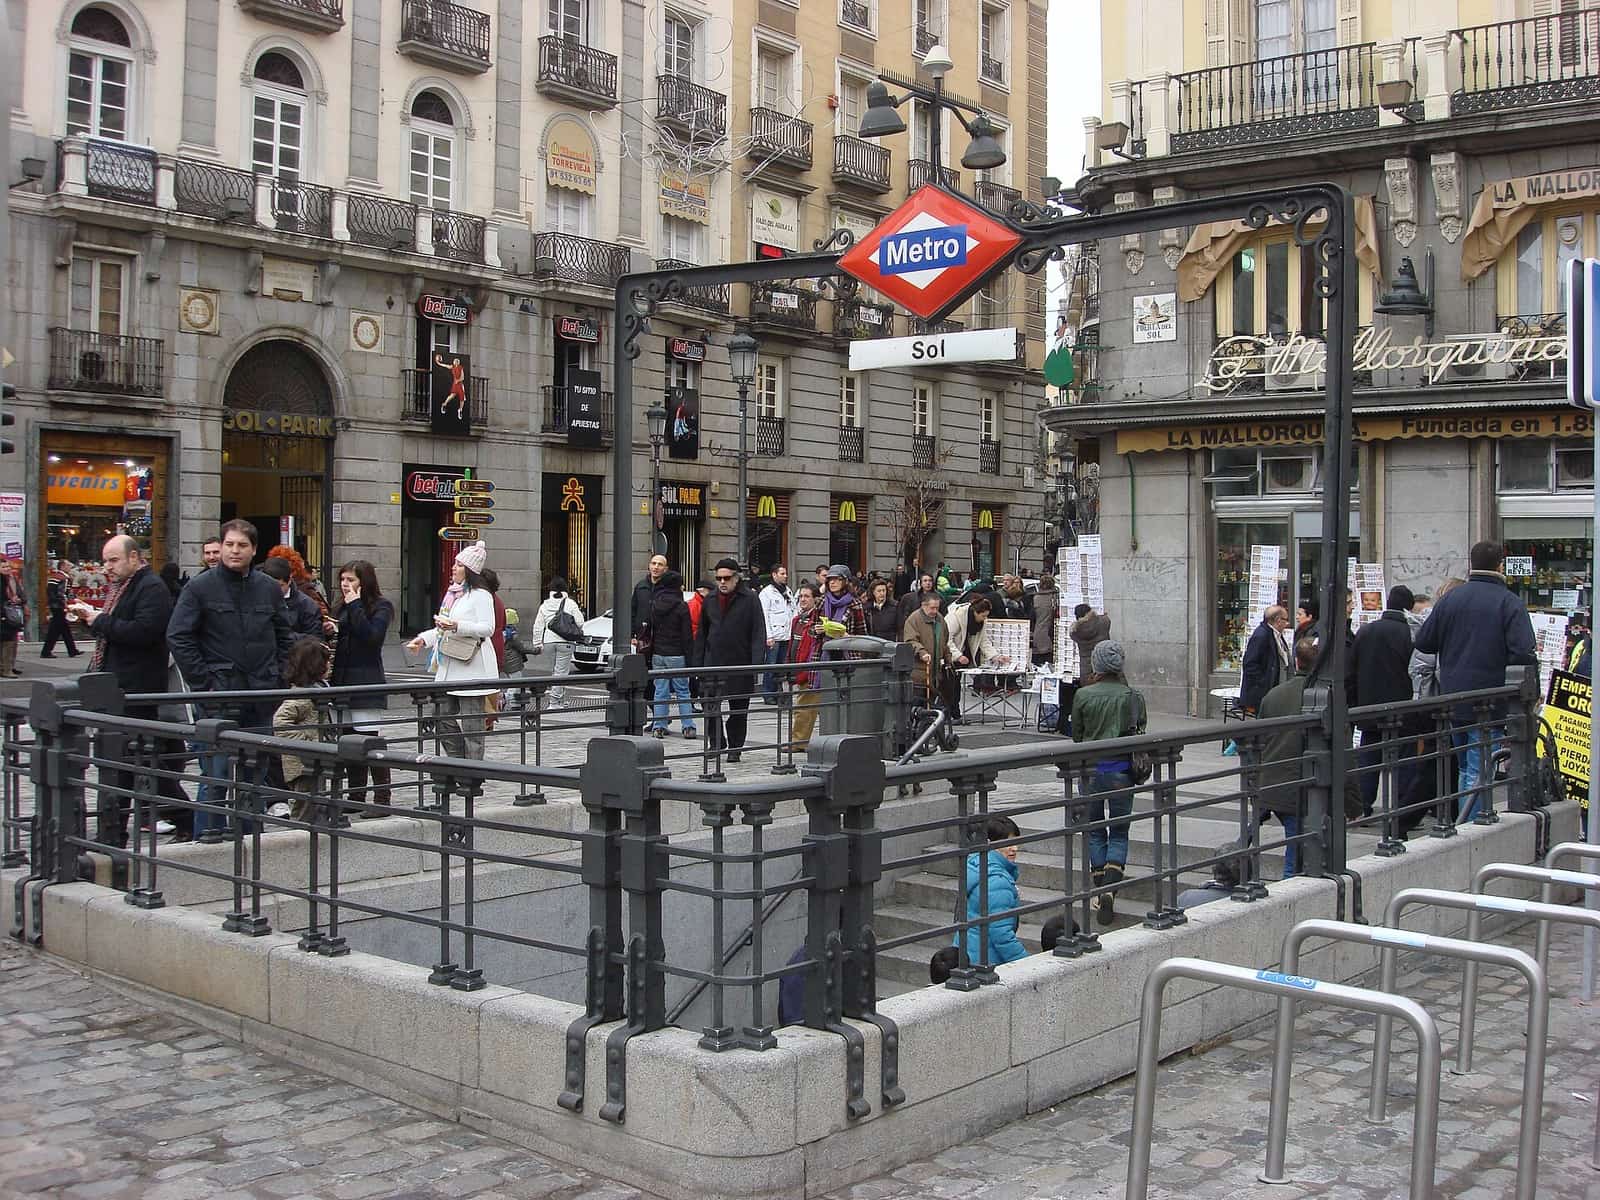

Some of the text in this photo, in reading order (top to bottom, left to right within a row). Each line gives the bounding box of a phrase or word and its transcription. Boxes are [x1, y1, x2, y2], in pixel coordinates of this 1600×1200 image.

[551, 156, 591, 174] TORREVIEJA
[1494, 181, 1516, 203] LA
[887, 236, 960, 266] Metro
[424, 297, 467, 319] betplus
[561, 318, 598, 338] betplus
[1146, 330, 1162, 339] SOL
[673, 339, 704, 357] betplus
[911, 339, 945, 359] Sol
[580, 403, 589, 412] DE
[280, 414, 335, 436] PARK
[571, 418, 600, 430] APUESTAS
[1402, 415, 1502, 434] Fundada
[1510, 418, 1540, 432] en
[1168, 430, 1194, 446] LA
[413, 474, 460, 498] betplu
[661, 486, 701, 504] SOL PARK
[1555, 722, 1562, 731] EL
